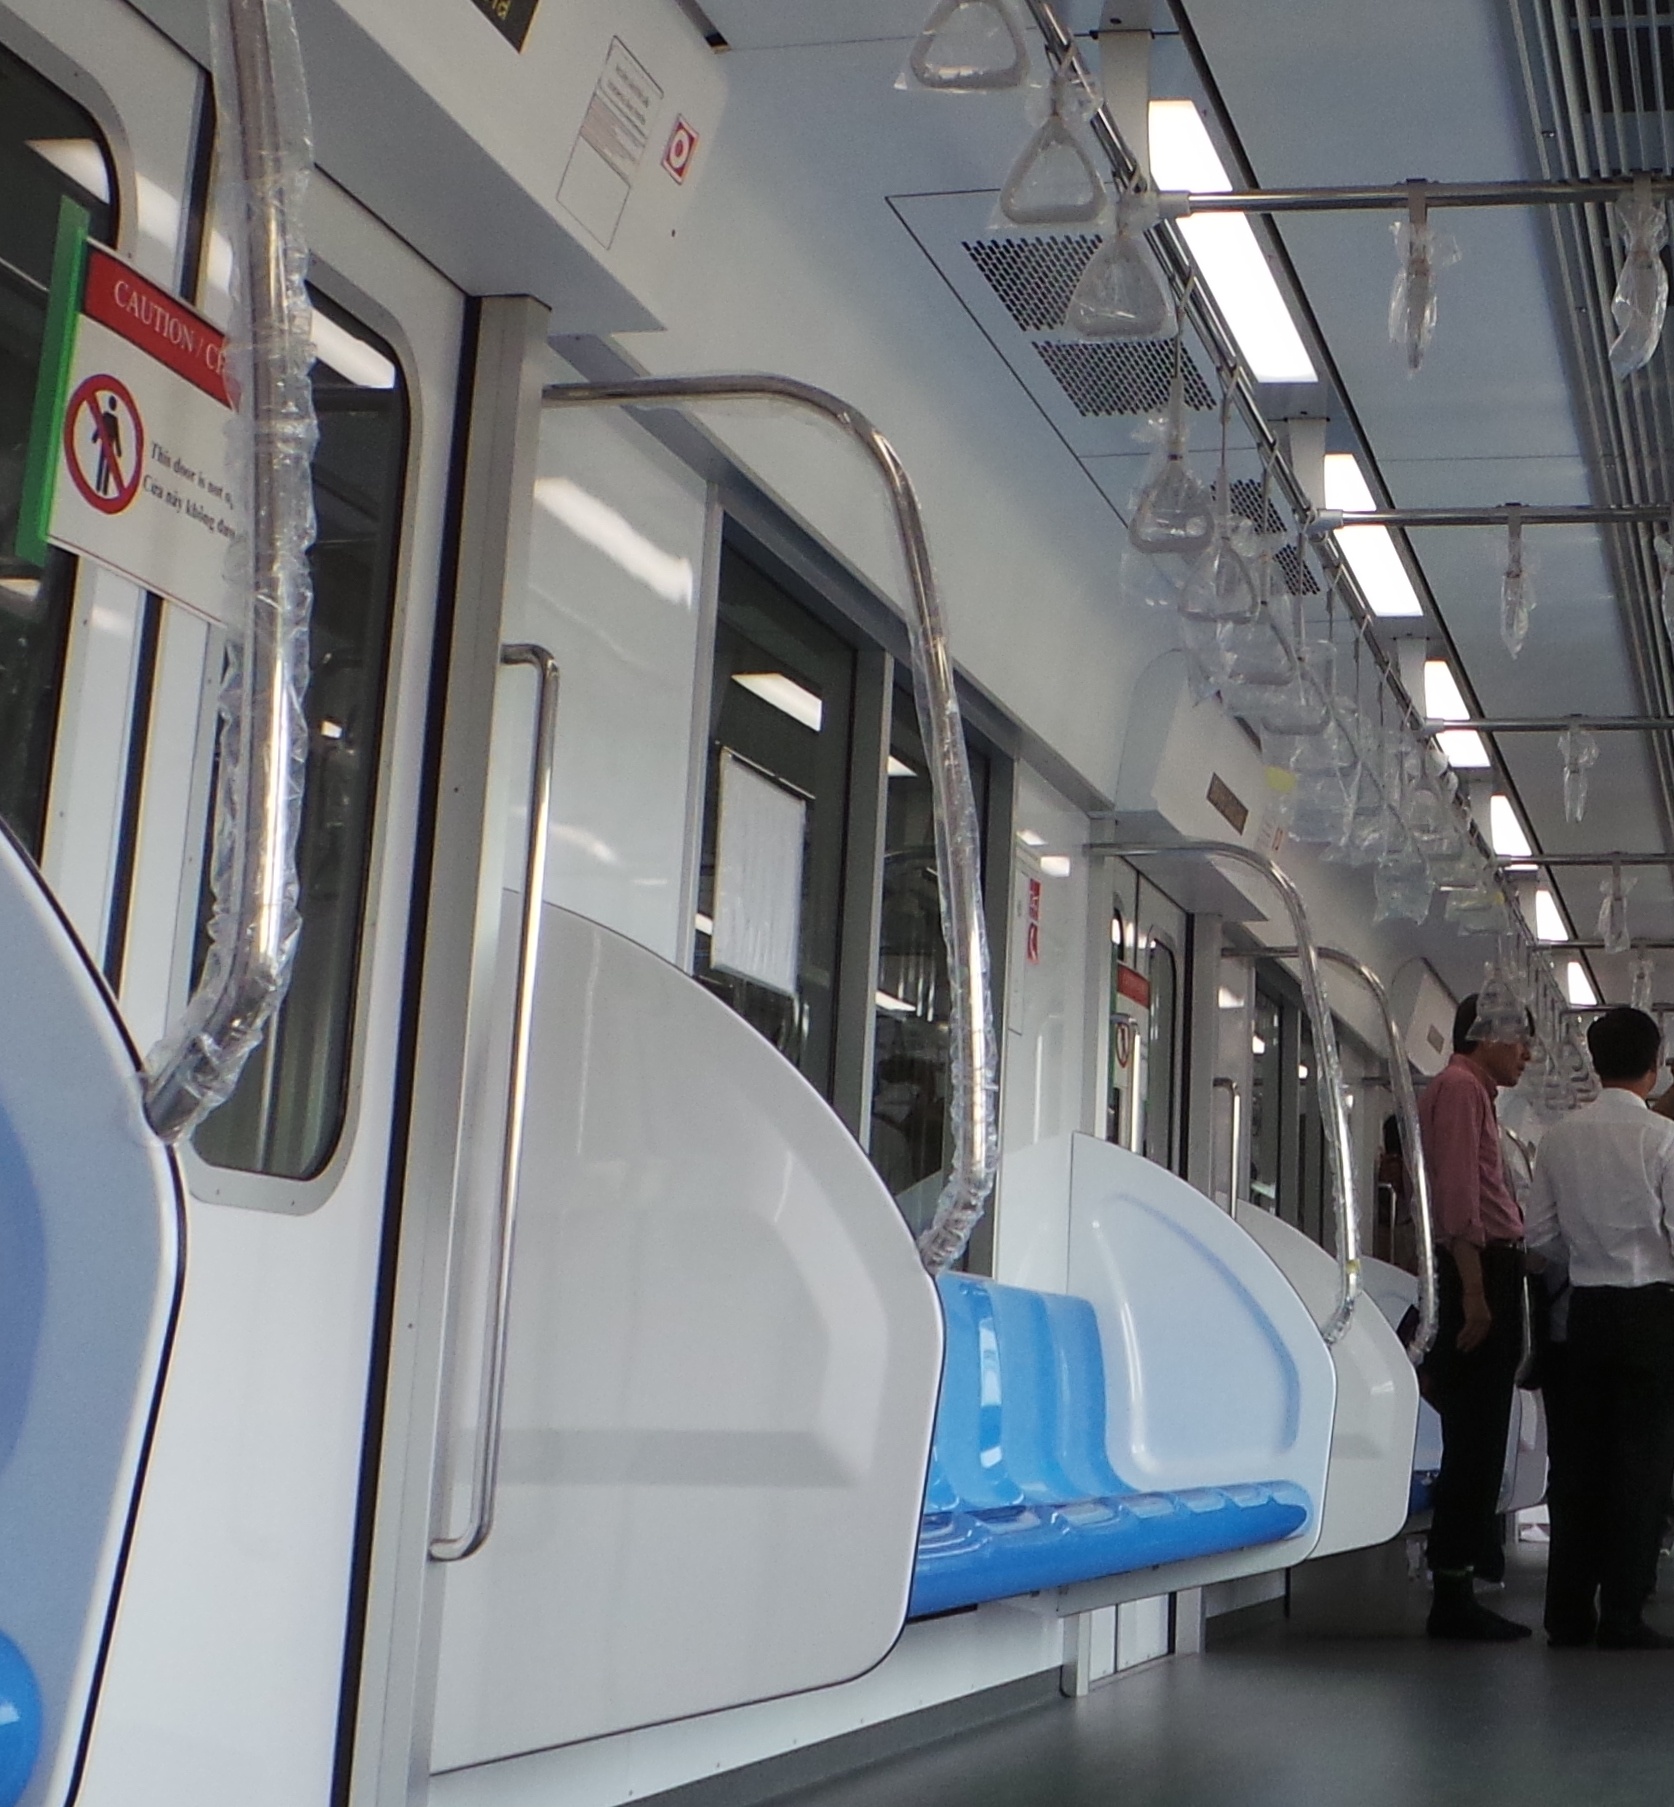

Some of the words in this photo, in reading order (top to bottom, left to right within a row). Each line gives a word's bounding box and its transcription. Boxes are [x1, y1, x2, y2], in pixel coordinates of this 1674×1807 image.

[114, 280, 195, 353] CAUTION
[151, 441, 171, 469] This
[174, 457, 196, 483] door
[197, 471, 206, 489] is
